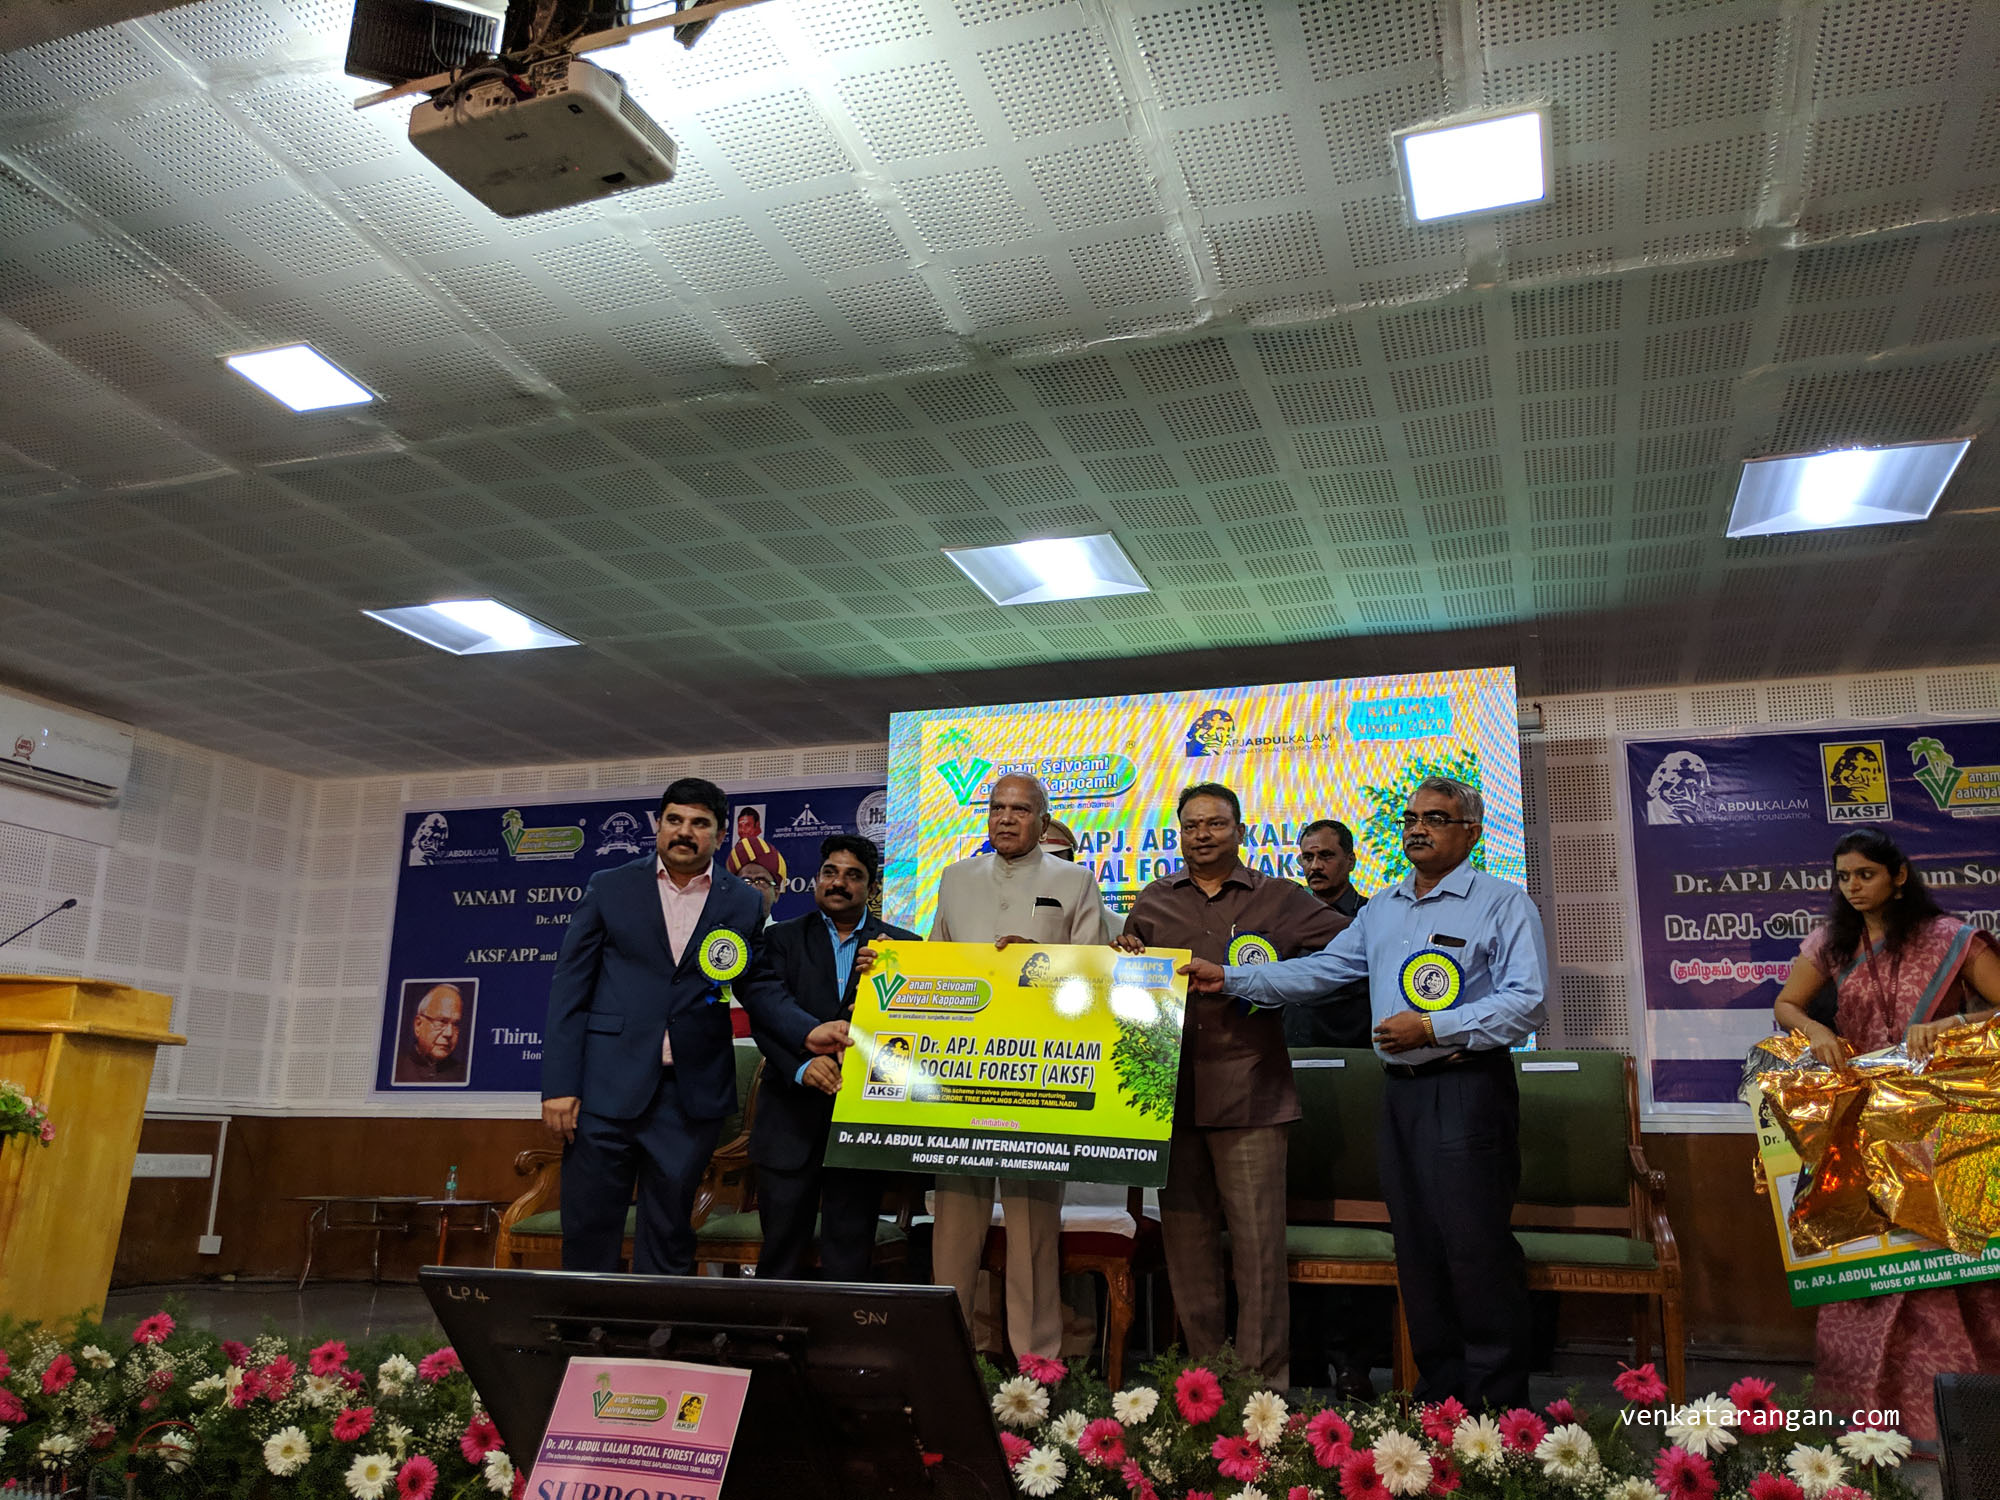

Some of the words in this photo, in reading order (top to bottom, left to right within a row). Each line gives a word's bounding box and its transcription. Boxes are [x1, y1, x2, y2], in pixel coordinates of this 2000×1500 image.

[1042, 756, 1109, 773] Seivoam!
[1835, 805, 1885, 818] AKSF
[1078, 830, 1132, 853] APJ.
[1674, 873, 1713, 893] Dr.
[1718, 871, 1771, 891] APJ
[1778, 869, 1833, 890] Abd
[453, 889, 517, 906] VANAM
[526, 886, 589, 904] SEIVO
[536, 915, 550, 925] Dr.
[551, 914, 572, 924] APJ
[1665, 916, 1700, 941] Dr.
[1704, 913, 1761, 940] APJ.
[464, 949, 508, 963] AKSF
[507, 948, 540, 962] APP
[540, 951, 558, 961] and
[908, 980, 932, 990] anam
[935, 980, 977, 992] Seivoam!
[1147, 974, 1169, 984] 2020
[932, 995, 980, 1006] Kappoam!!
[491, 1027, 543, 1045] Thiru.
[919, 1035, 940, 1054] Dr.
[945, 1037, 979, 1056] APJ.
[984, 1038, 1037, 1059] ABDUL
[1042, 1040, 1101, 1061] KALAM
[918, 1058, 973, 1080] SOCIAL
[978, 1063, 1037, 1083] FOREST
[1041, 1064, 1095, 1090] (AKSF)
[868, 1086, 903, 1097] AKSF
[1000, 1090, 1024, 1098] planting
[964, 1095, 980, 1103] TREE
[1013, 1098, 1040, 1106] ACROSS
[838, 1131, 854, 1144] Dr.
[856, 1131, 882, 1145] APJ.
[884, 1133, 924, 1148] ABDUL
[927, 1135, 969, 1150] KALAM
[972, 1138, 1071, 1156] INTERNATIONAL
[1074, 1144, 1158, 1162] FOUNDATION
[1763, 1135, 1780, 1147] Dr.
[912, 1153, 944, 1164] HOUSE
[946, 1155, 959, 1165] OF
[960, 1156, 994, 1167] KALAM
[1000, 1158, 1070, 1172] RAMESWARAM
[1794, 1277, 1808, 1291] Dr.
[1811, 1273, 1836, 1288] APJ.
[1838, 1266, 1877, 1284] ABDUL
[1878, 1259, 1921, 1277] KALAM
[1870, 1279, 1902, 1291] HOUSE
[1903, 1277, 1917, 1287] OF
[1918, 1270, 1952, 1284] KALAM
[676, 1422, 696, 1430] AKSF
[546, 1438, 557, 1450] Dr.
[557, 1440, 575, 1451] APJ.
[575, 1440, 601, 1452] ABDUL
[601, 1442, 631, 1455] KALAM
[631, 1444, 661, 1458] SOCIAL
[662, 1448, 695, 1462] FOREST
[694, 1452, 724, 1468] (AKSF)
